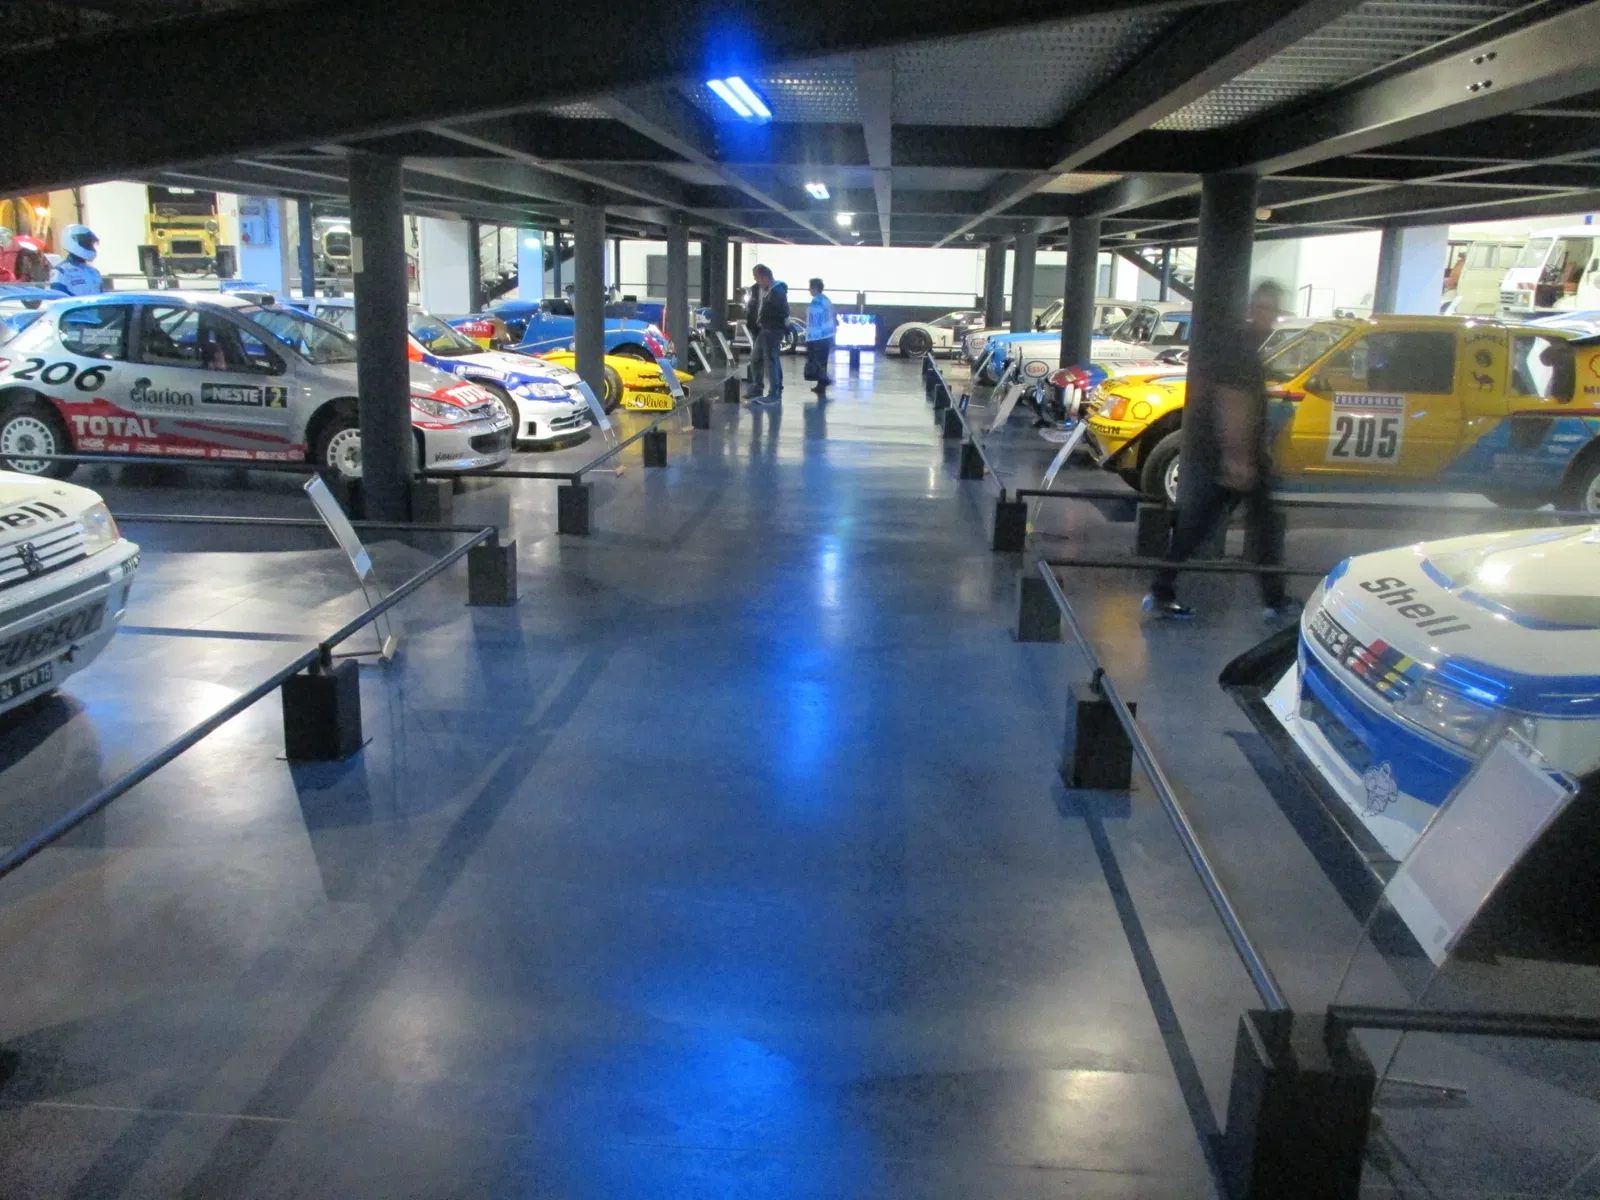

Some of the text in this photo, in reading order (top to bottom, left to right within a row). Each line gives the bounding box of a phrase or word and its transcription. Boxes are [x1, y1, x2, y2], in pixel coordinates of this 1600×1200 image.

[463, 324, 488, 332] TOTAL
[11, 357, 113, 392] 206
[1027, 364, 1046, 374] ESSO
[212, 386, 260, 403] NESTE
[270, 387, 282, 408] 2
[71, 415, 158, 438] TOTAL
[1332, 416, 1399, 458] 205
[0, 501, 67, 532] ell
[1359, 577, 1472, 637] Shell
